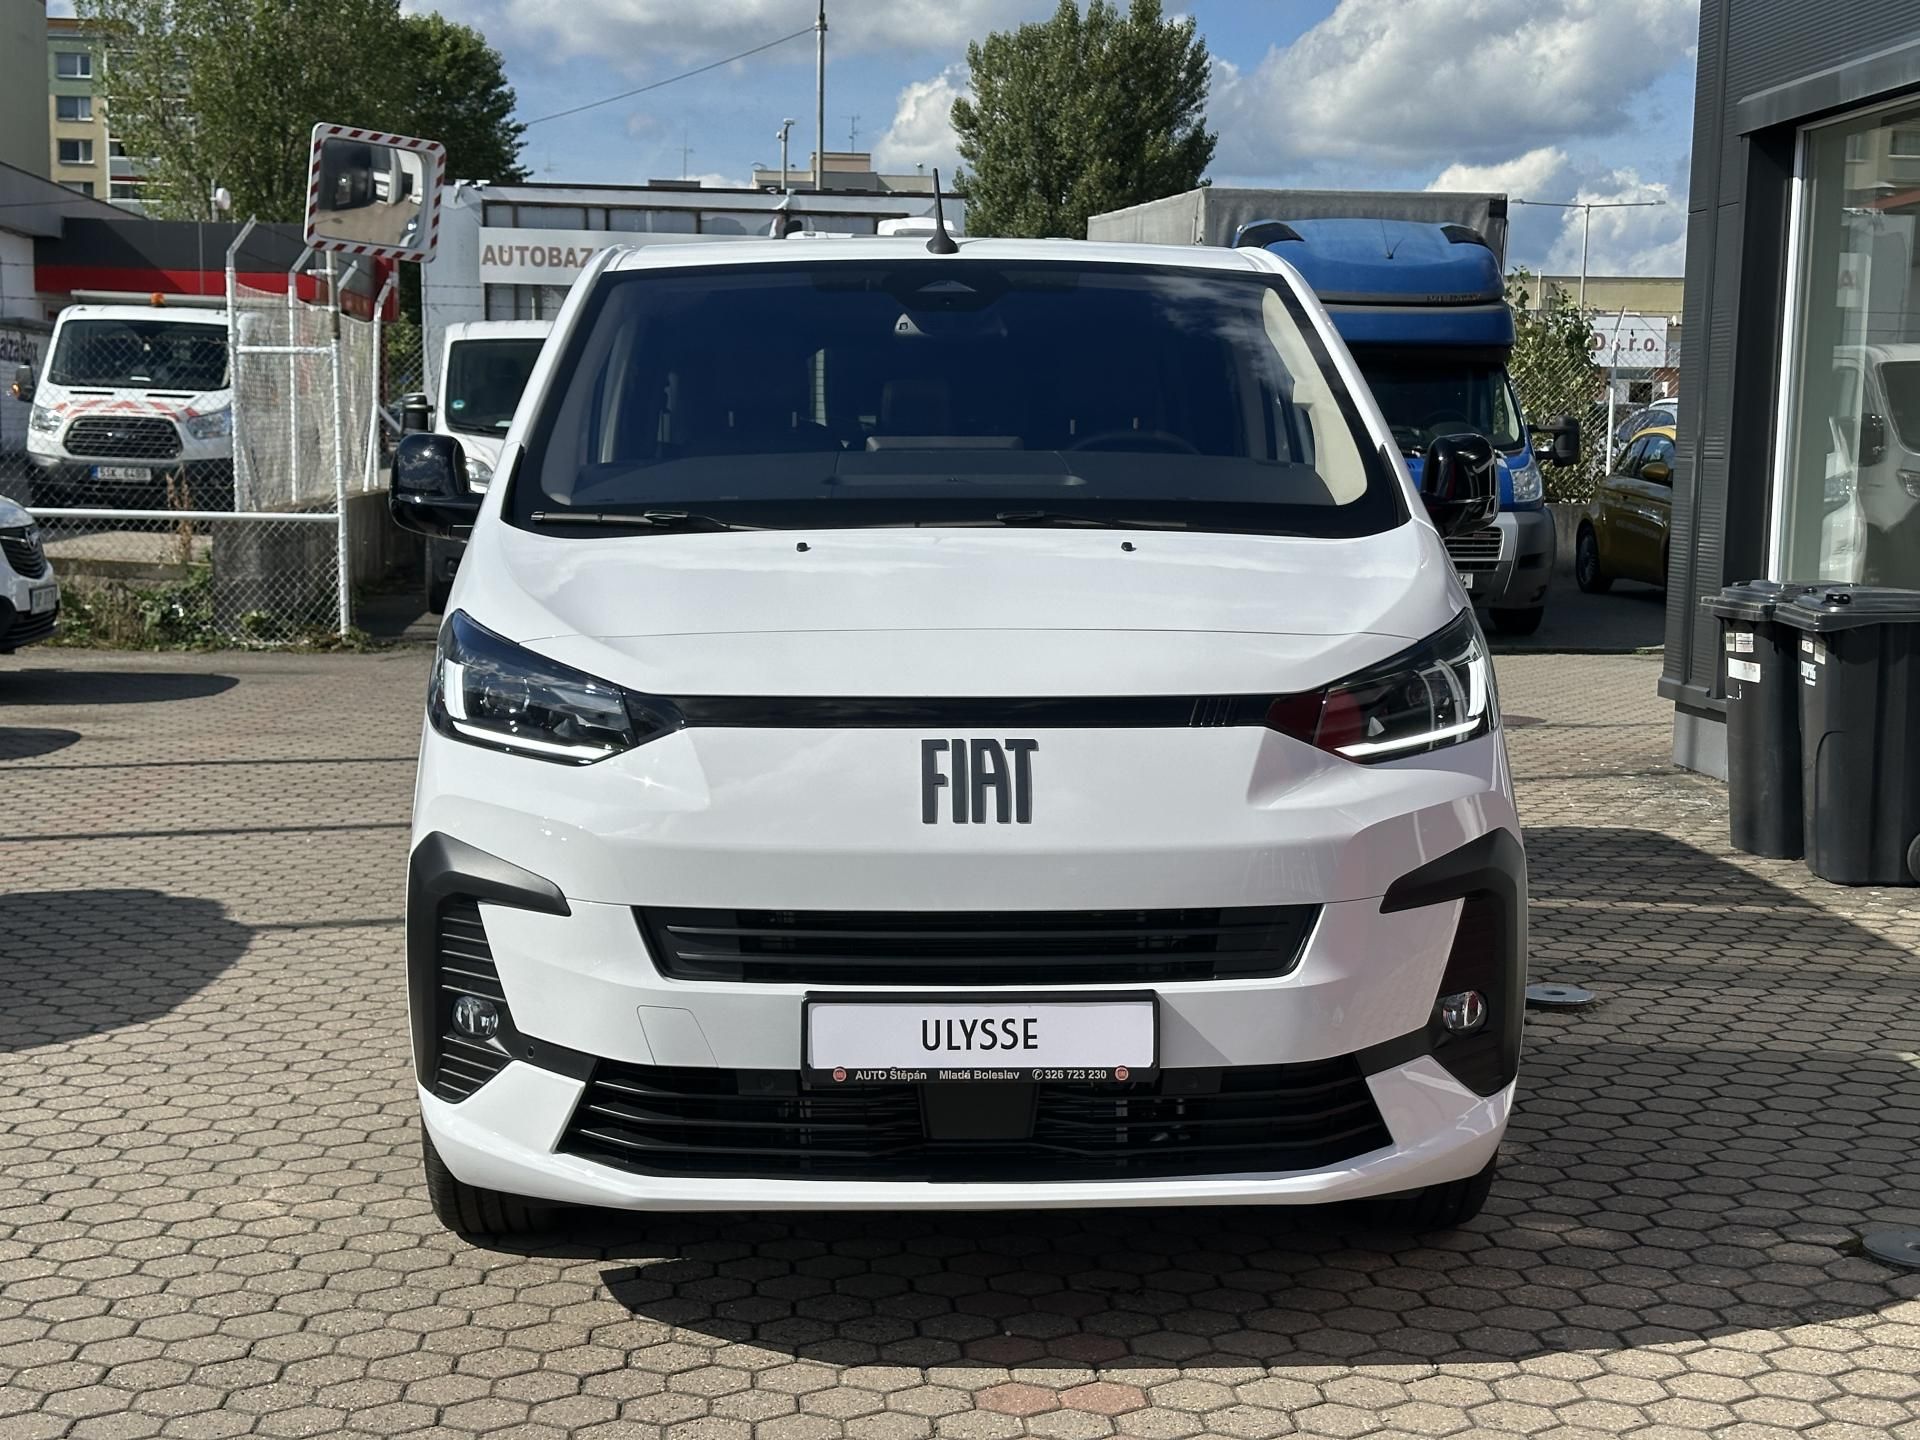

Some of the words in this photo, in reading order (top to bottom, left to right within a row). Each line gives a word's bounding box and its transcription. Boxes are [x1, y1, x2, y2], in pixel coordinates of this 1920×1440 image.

[482, 245, 604, 268] AUTOBAZ
[921, 738, 1040, 825] FIAT
[921, 1018, 1039, 1051] ULYSSE
[855, 1070, 887, 1080] AUTO
[889, 1068, 927, 1082] Štěpán
[939, 1069, 971, 1080] Mladá
[974, 1069, 1020, 1080] Boleslav
[1045, 1070, 1064, 1079] 326
[1066, 1070, 1086, 1079] 723
[1088, 1070, 1107, 1079] 230
